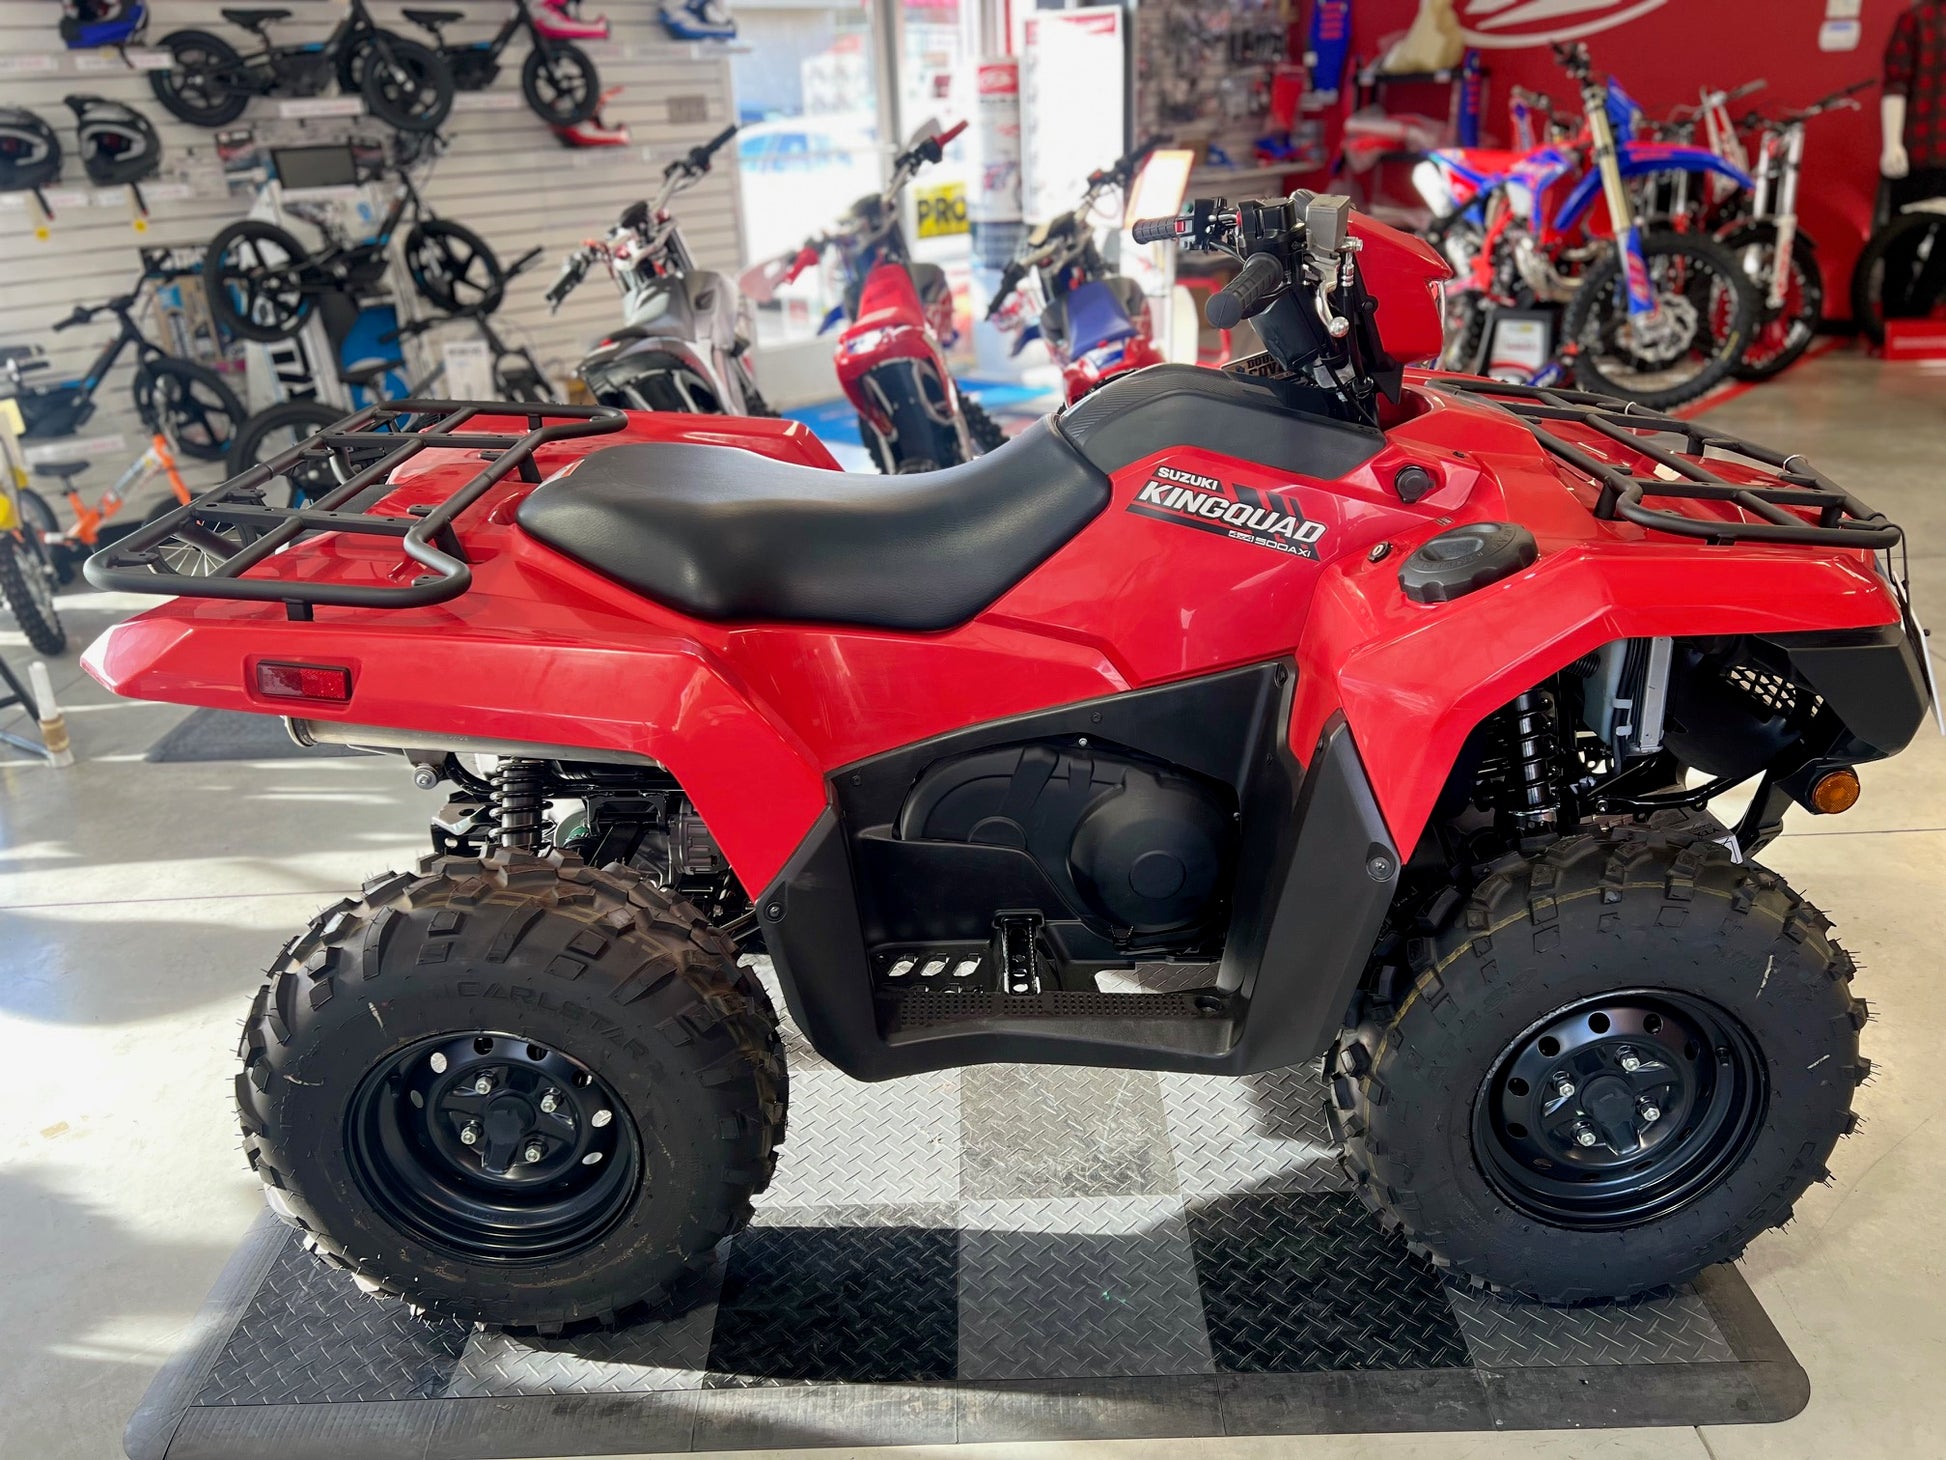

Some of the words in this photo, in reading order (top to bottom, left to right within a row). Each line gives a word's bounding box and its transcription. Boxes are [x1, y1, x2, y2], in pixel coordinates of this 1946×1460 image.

[1157, 466, 1220, 491] SUZUKI
[1138, 481, 1328, 544] KINGQUAD
[456, 981, 650, 1061] CARLSTAR
